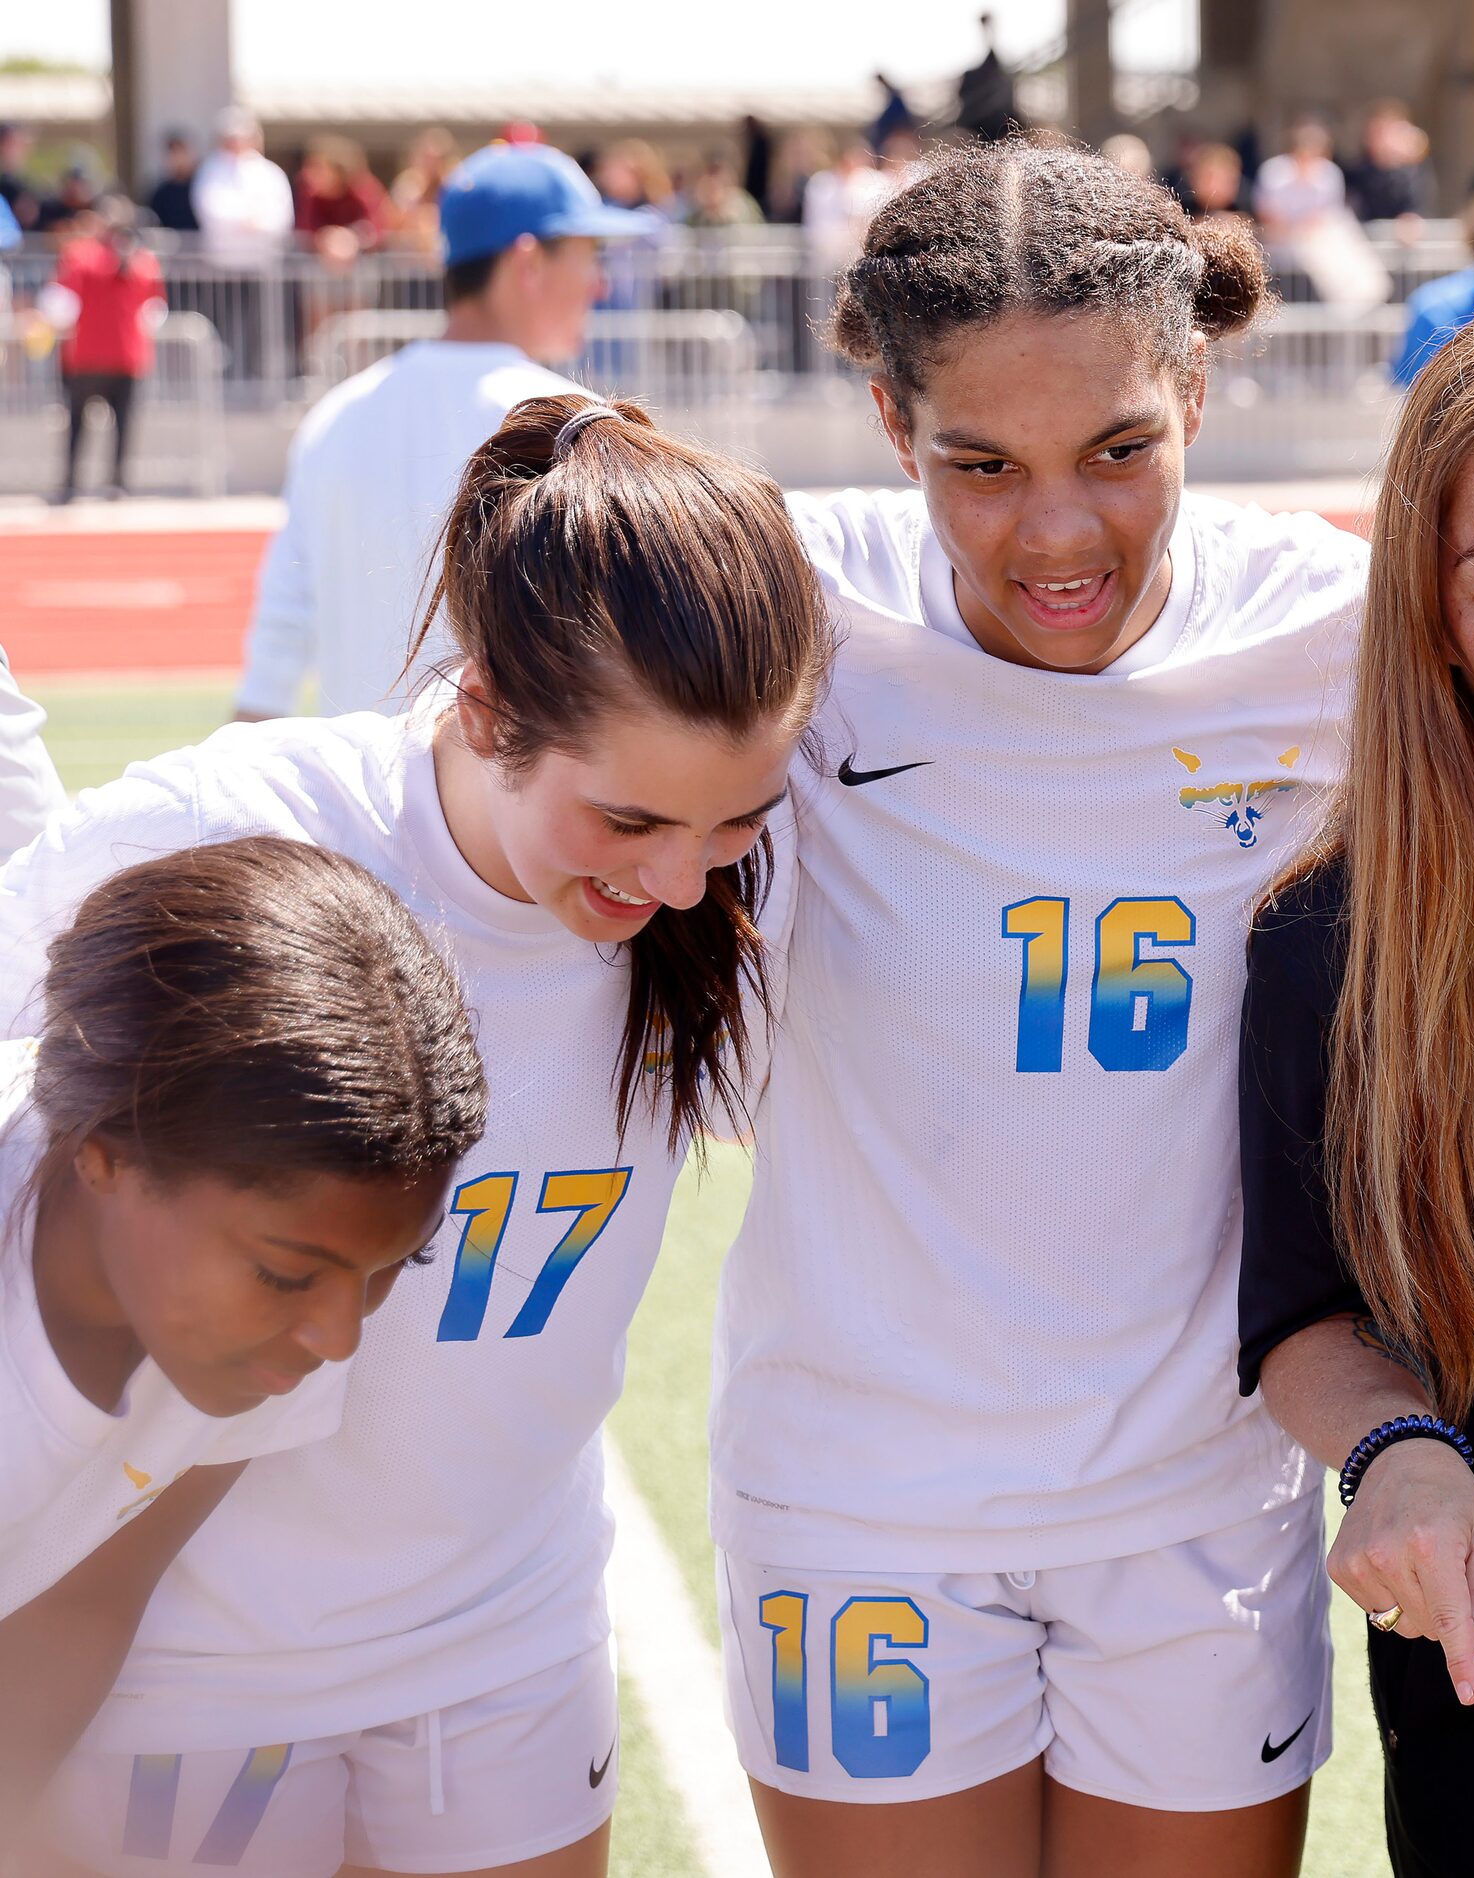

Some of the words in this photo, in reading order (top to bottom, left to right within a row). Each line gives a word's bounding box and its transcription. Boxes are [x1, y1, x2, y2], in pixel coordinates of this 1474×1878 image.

[1002, 894, 1197, 1073] 16
[436, 1166, 634, 1343] 17
[758, 1589, 932, 1779] 16
